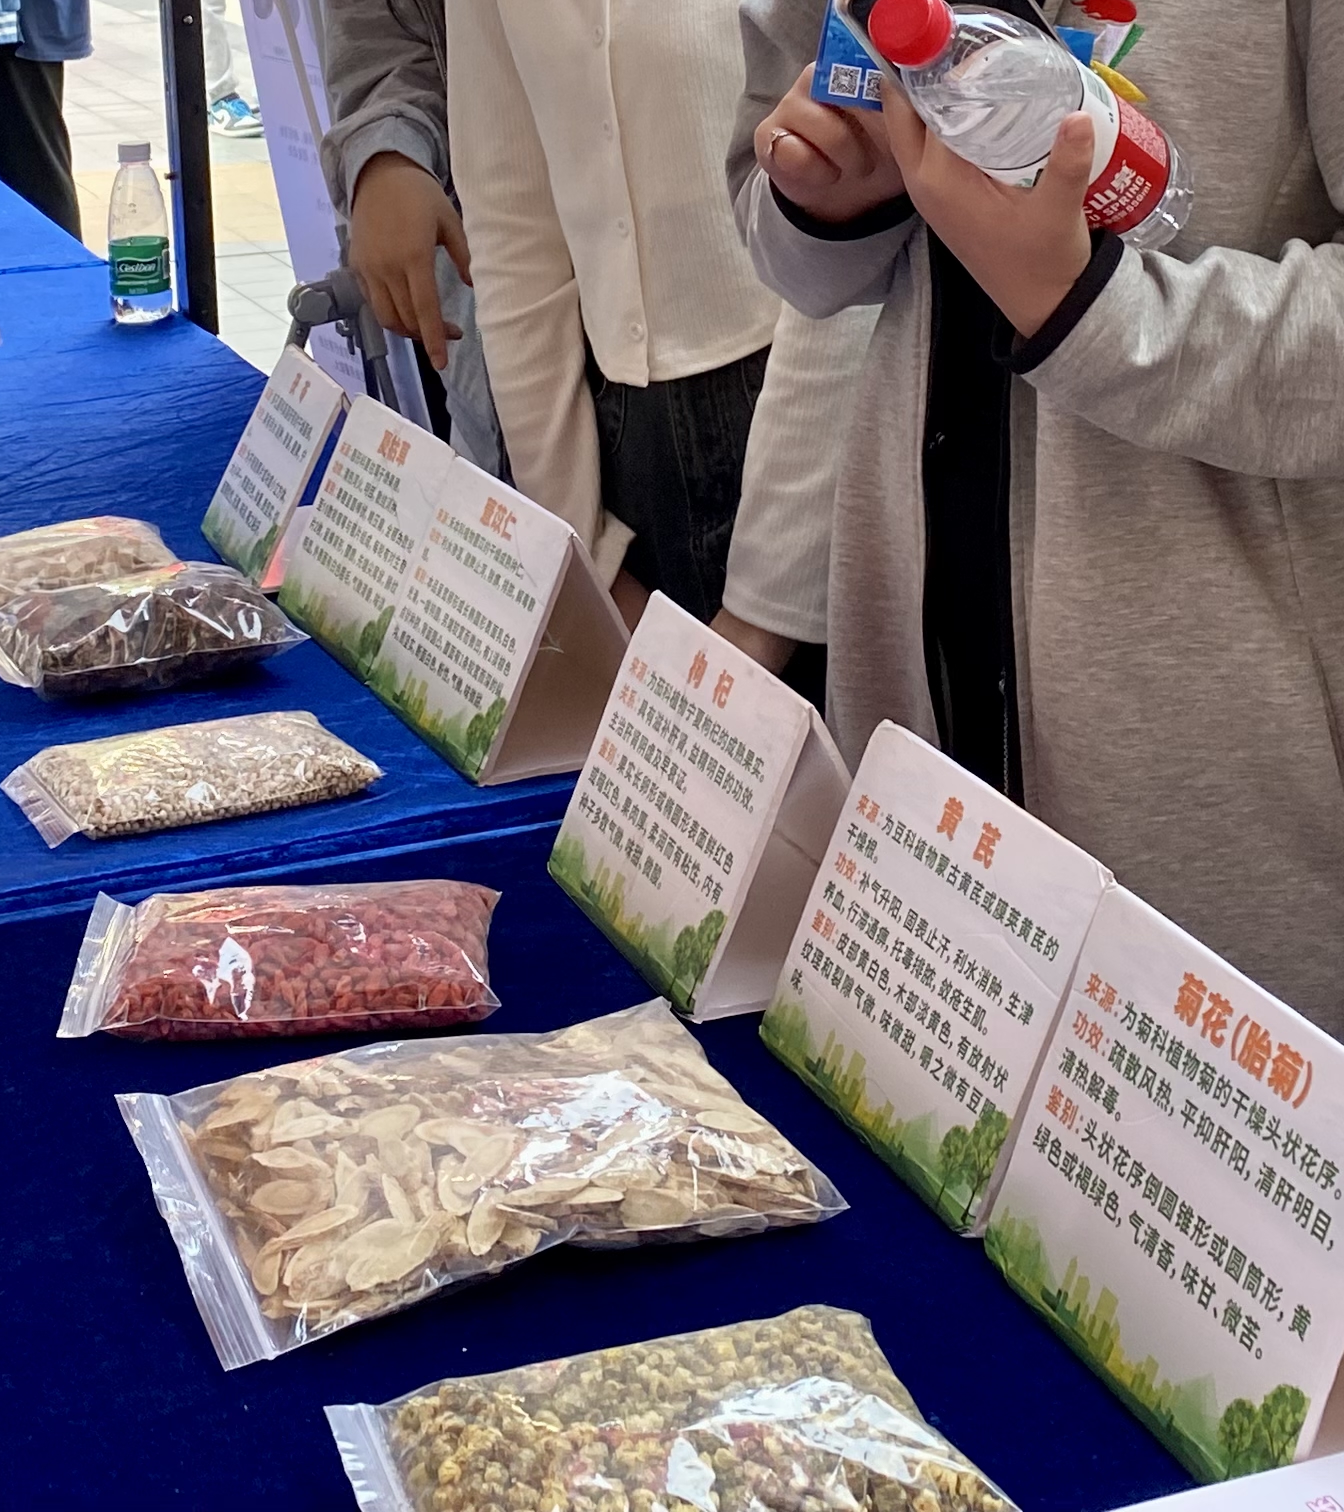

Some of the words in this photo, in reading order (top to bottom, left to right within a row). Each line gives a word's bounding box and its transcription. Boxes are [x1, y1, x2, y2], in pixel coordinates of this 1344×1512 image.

[1102, 175, 1146, 217] SPRING
[684, 648, 736, 711] 枸杞
[934, 792, 1004, 872] 黄芪
